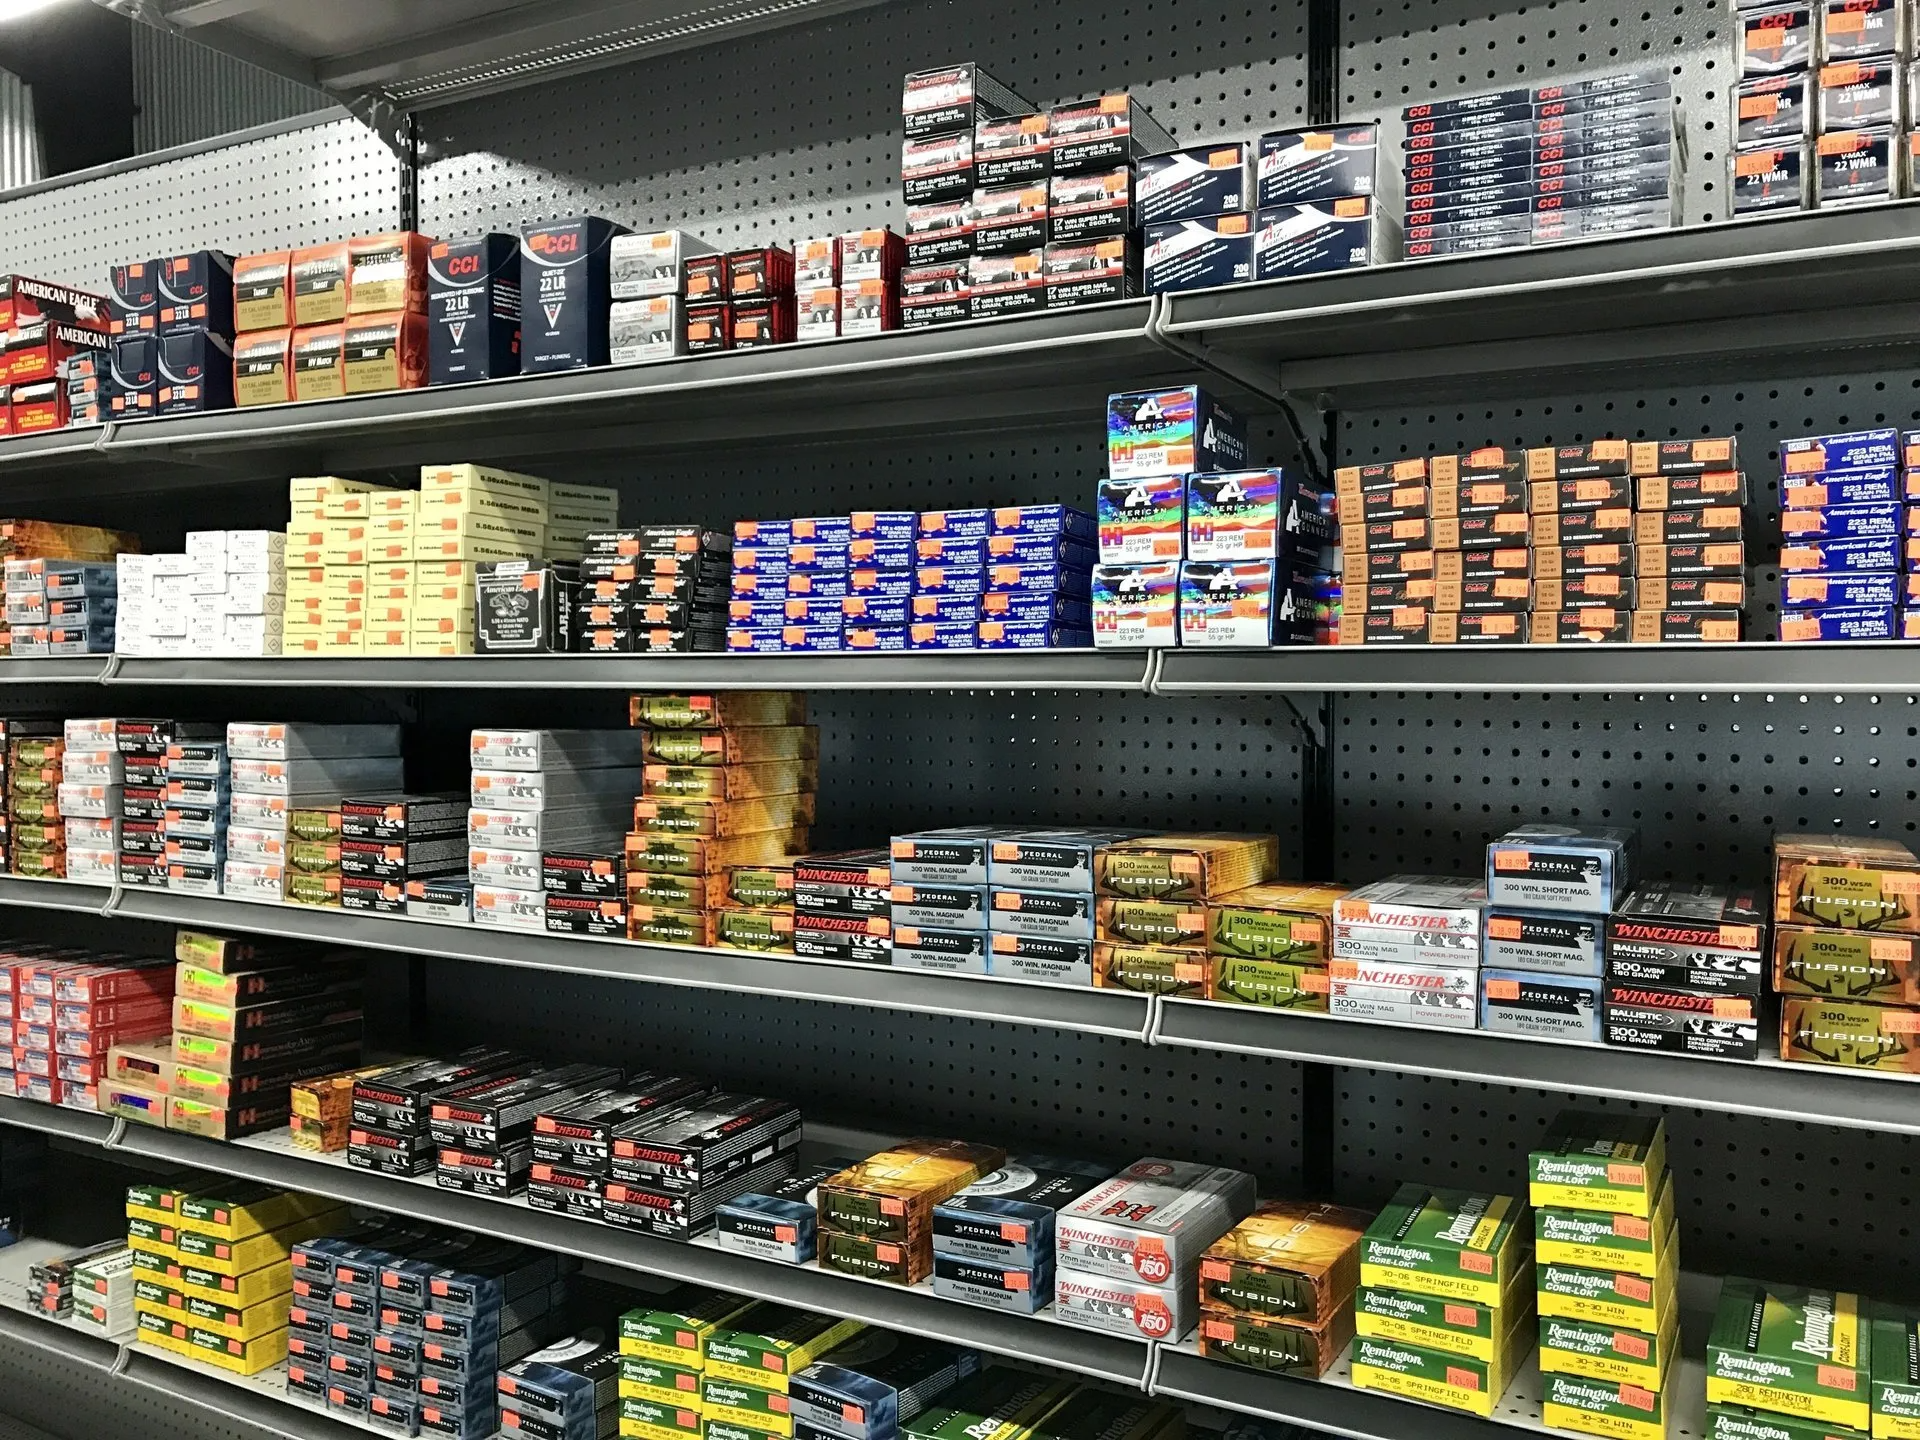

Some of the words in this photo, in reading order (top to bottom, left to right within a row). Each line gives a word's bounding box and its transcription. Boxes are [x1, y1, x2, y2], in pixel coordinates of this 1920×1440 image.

[1760, 14, 1795, 28] CCI
[908, 73, 957, 89] WINCHESTER
[1845, 83, 1869, 91] V-MAX
[1538, 88, 1563, 99] CCI
[1838, 92, 1851, 103] 22
[1853, 91, 1880, 102] WMR
[1409, 106, 1432, 118] CCI
[1413, 121, 1435, 133] CCI
[1841, 151, 1868, 159] V-MAX
[1834, 161, 1848, 172] 22
[1850, 157, 1877, 169] WMR
[1355, 176, 1371, 186] 200
[1747, 174, 1761, 186] 22
[1762, 170, 1789, 183] WMR
[1223, 195, 1239, 206] 200
[543, 233, 578, 254] CCI
[1350, 248, 1366, 258] 200
[449, 255, 479, 276] CCI
[1234, 263, 1249, 274] 200
[540, 278, 552, 291] 22
[553, 275, 566, 290] LR
[17, 280, 67, 304] AMERICAN
[69, 292, 97, 312] EAGLE
[190, 285, 203, 295] CCI
[445, 298, 456, 312] 22
[457, 296, 469, 310] LR
[56, 325, 106, 349] AMERICAN
[1826, 435, 1867, 445] American
[1869, 431, 1894, 439] Eagle
[1827, 508, 1868, 517] American
[1870, 506, 1895, 515] Eagle
[1848, 518, 1867, 526] 223
[1870, 517, 1894, 525] REM.
[343, 806, 383, 815] WINCHESTER
[295, 825, 333, 833] FUSION
[924, 850, 960, 858] FEDERAL
[1024, 851, 1062, 860] FEDERAL
[544, 857, 591, 868] WINCHESTER
[1118, 861, 1135, 869] 300
[1528, 861, 1576, 870] FEDERAL
[1110, 877, 1182, 886] FUSION
[1822, 876, 1848, 886] 300
[1850, 880, 1873, 888] WSM
[734, 889, 787, 897] FUSION
[1521, 885, 1540, 893] WIN.
[1542, 886, 1569, 895] SHORT
[1570, 888, 1591, 896] MAG.
[1801, 895, 1897, 909] FUSION
[1119, 923, 1191, 934] FUSION
[1226, 932, 1303, 946] FUSION
[1338, 941, 1361, 949] 300
[1499, 947, 1514, 955] 300
[1516, 948, 1535, 956] WIN.
[1536, 950, 1563, 959] SHORT
[1564, 953, 1585, 962] MAG.
[1613, 944, 1665, 955] BALLISTIC
[1419, 952, 1470, 960] POWER-POINT
[1613, 962, 1640, 971] 300
[1643, 967, 1665, 975] WSM
[355, 1087, 404, 1104] WINCHESTER
[431, 1119, 454, 1128] BALLISTIC
[1537, 1173, 1591, 1185] CORE-LOKT
[1566, 1190, 1594, 1198] 30-30
[831, 1212, 890, 1227] FUSION
[744, 1223, 774, 1234] FEDERAL
[964, 1226, 1000, 1237] FEDERAL
[1060, 1227, 1135, 1249] WINCHESTER
[950, 1240, 964, 1248] 7mm
[981, 1244, 1010, 1255] MAGNUM
[1139, 1259, 1165, 1277] 150
[1368, 1256, 1416, 1268] CORE-LOKT
[1382, 1270, 1410, 1281] 30-06
[1415, 1276, 1479, 1292] SPRINGFIELD
[1220, 1287, 1296, 1308] FUSION
[1365, 1305, 1411, 1319] CORE-LOKT
[1751, 1303, 1763, 1332] CARTRIDGES
[1748, 1332, 1758, 1348] RIFLE
[1716, 1369, 1772, 1384] CORE-LOKT
[520, 1389, 547, 1404] FEDERAL
[1736, 1384, 1754, 1394] 280
[1759, 1388, 1811, 1404] REMINGTON
